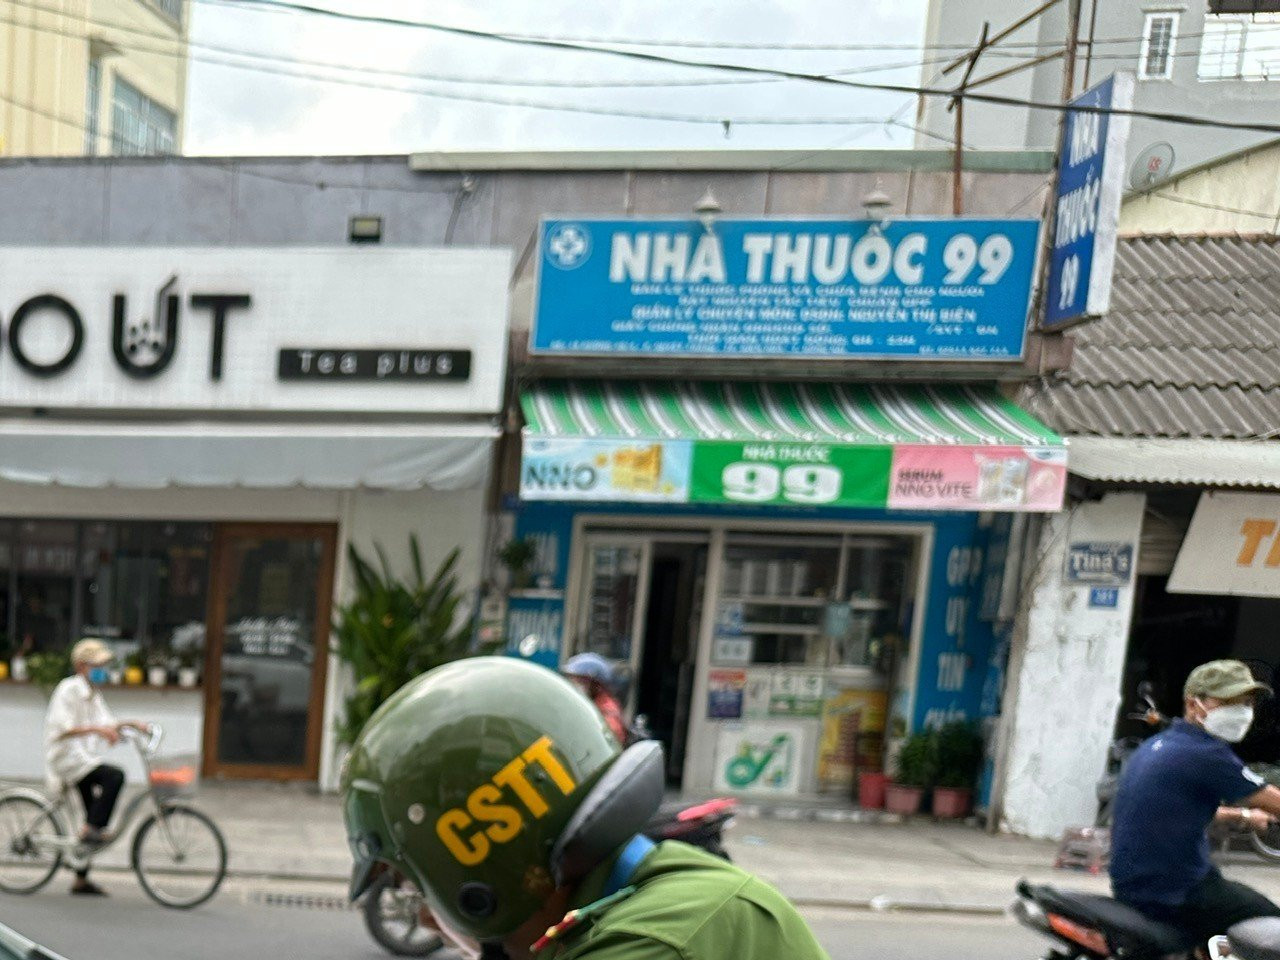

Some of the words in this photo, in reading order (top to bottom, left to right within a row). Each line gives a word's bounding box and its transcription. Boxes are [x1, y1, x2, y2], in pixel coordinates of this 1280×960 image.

[608, 228, 728, 285] NHÀ
[741, 226, 929, 286] THUỐC
[942, 232, 1015, 286] 99
[1058, 253, 1080, 311] 99
[297, 350, 358, 375] Tea
[376, 350, 454, 378] plus
[524, 463, 597, 491] NNO
[721, 461, 843, 503] 99
[435, 736, 578, 867] CSTT
